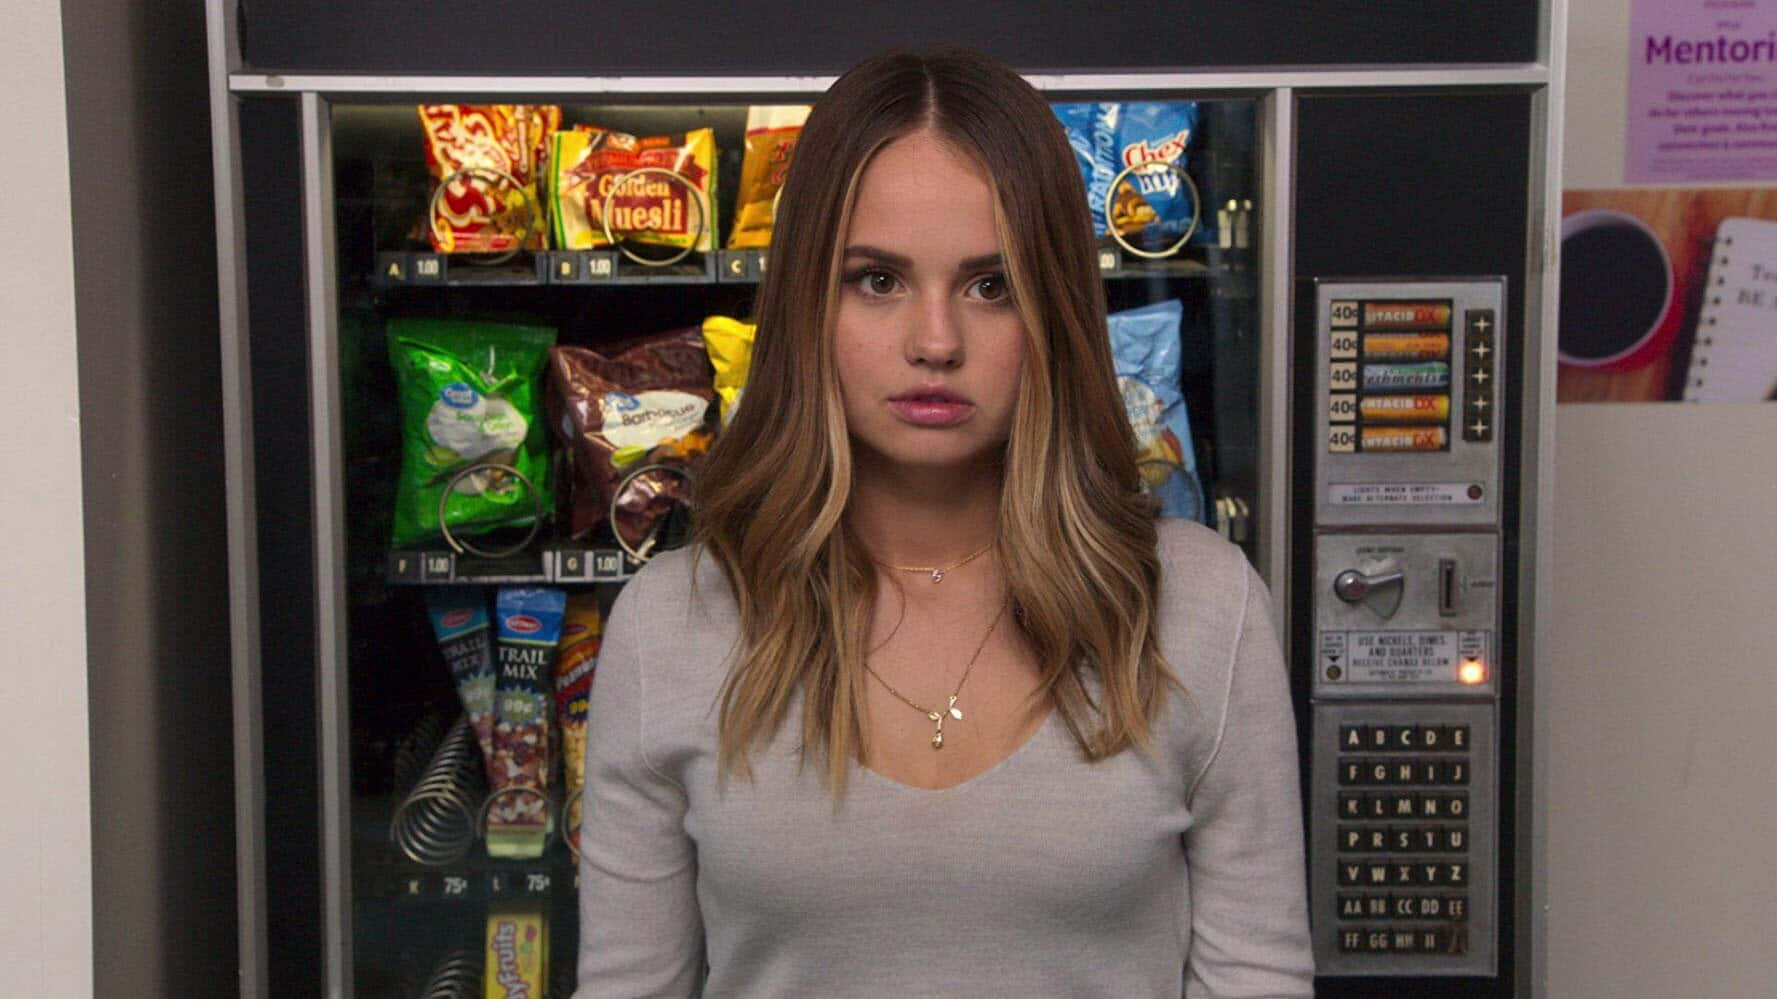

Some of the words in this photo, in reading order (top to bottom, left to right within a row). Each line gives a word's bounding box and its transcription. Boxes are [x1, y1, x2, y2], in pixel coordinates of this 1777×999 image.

[1646, 31, 1776, 64] Mentori
[1124, 131, 1190, 172] Chex
[599, 173, 671, 198] Golden
[590, 198, 683, 231] Muesli
[389, 262, 400, 275] A
[417, 259, 439, 275] 1.00
[590, 259, 611, 275] 1.00
[731, 260, 741, 273] C
[428, 558, 449, 573] 1.00
[597, 557, 617, 571] 1.00
[1358, 635, 1374, 646] USE
[499, 647, 547, 665] TRAIL
[1368, 647, 1386, 657] AND
[1389, 647, 1435, 657] QUARTERS
[503, 663, 538, 680] MIX
[1348, 730, 1359, 745] A
[1375, 730, 1385, 745] B
[1400, 730, 1410, 745] C
[1425, 730, 1437, 746] D
[1454, 730, 1462, 746] E
[1349, 765, 1357, 779] F
[1374, 765, 1386, 780] G
[1400, 765, 1411, 780] H
[1428, 765, 1434, 780] I
[1454, 765, 1462, 780] J
[1348, 800, 1357, 813] K
[1375, 799, 1383, 815] L
[1398, 799, 1412, 813] M
[1425, 800, 1436, 814] N
[1450, 799, 1463, 815] O
[1348, 831, 1359, 847] P
[1373, 832, 1383, 847] R
[1399, 832, 1409, 848] S
[1425, 831, 1434, 847] T
[1450, 832, 1462, 847] U
[1348, 866, 1359, 881] V
[1371, 867, 1386, 882] W
[1400, 866, 1409, 881] X
[1426, 867, 1436, 881] Y
[1451, 865, 1461, 881] Z
[1344, 900, 1362, 914] AA
[1397, 899, 1413, 914] CC
[1421, 899, 1440, 915] DD
[1345, 932, 1359, 948] FF
[1369, 933, 1388, 949] GG
